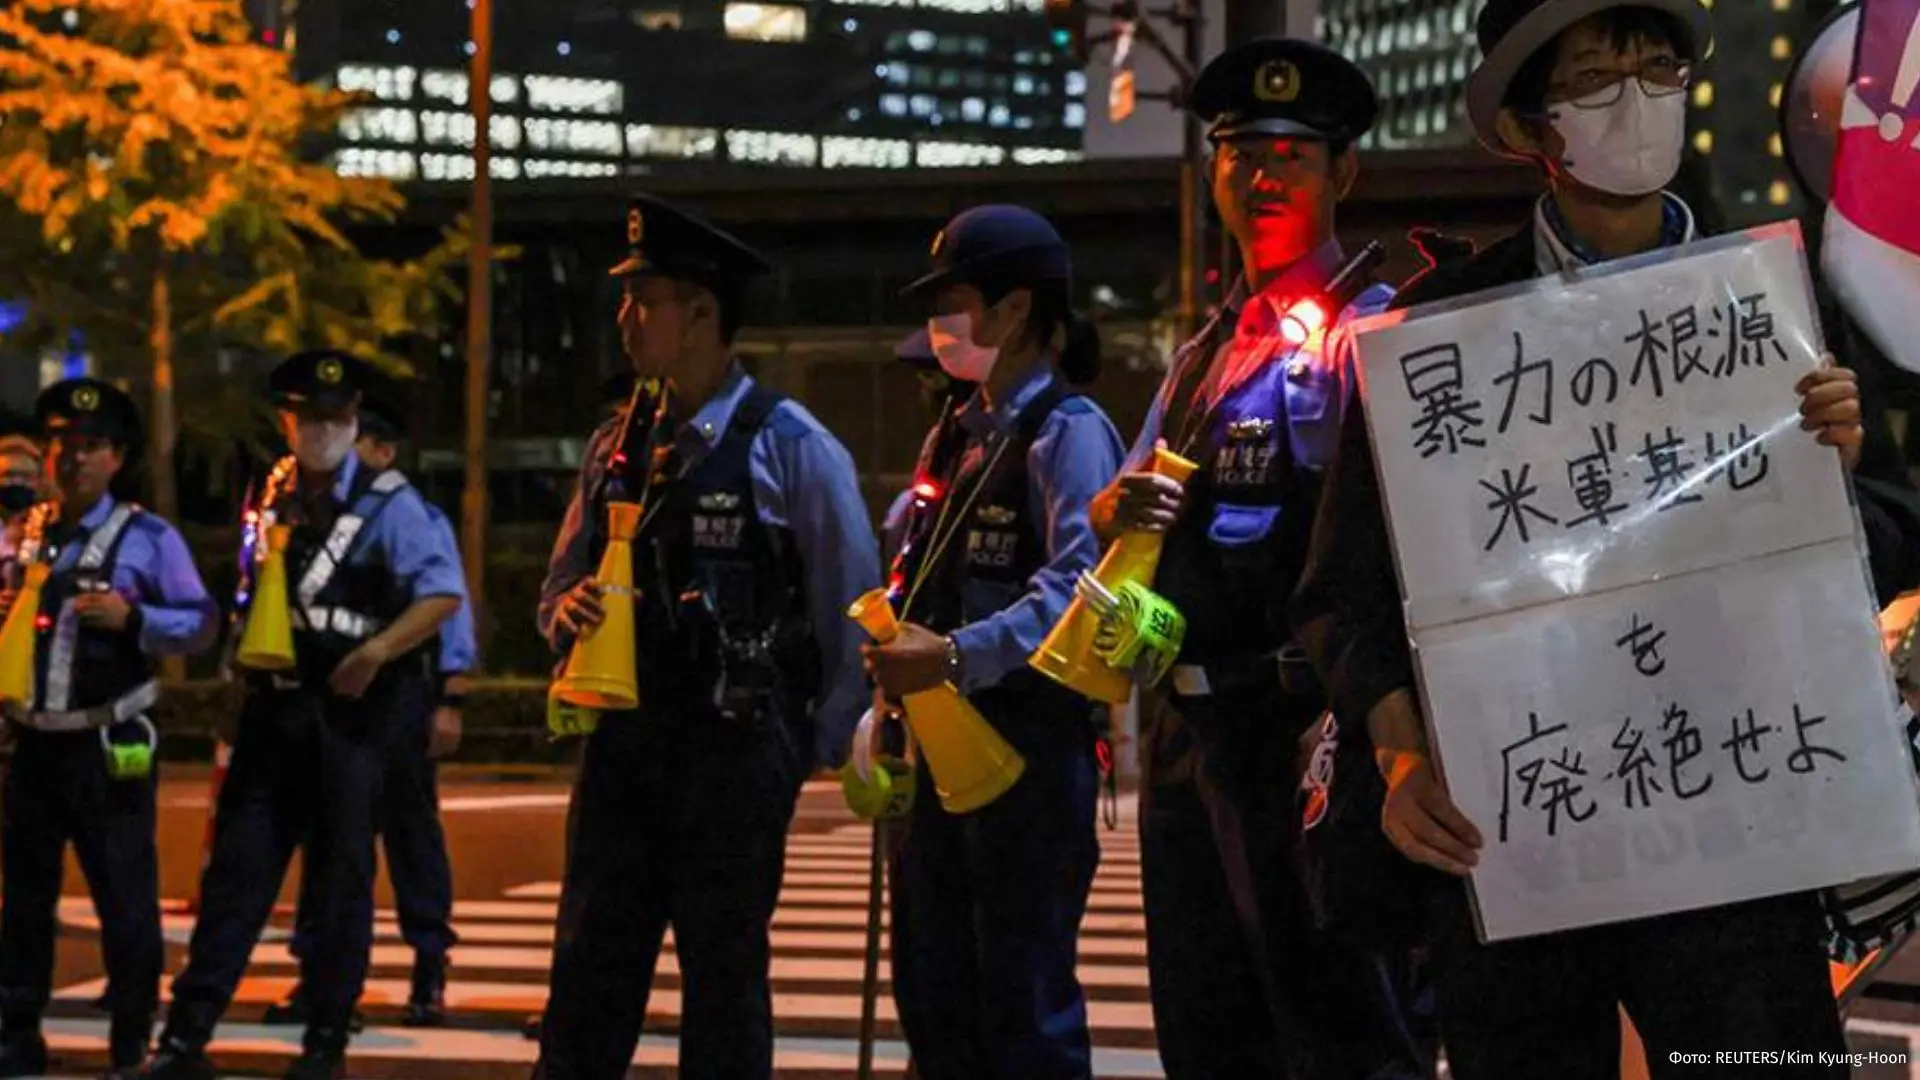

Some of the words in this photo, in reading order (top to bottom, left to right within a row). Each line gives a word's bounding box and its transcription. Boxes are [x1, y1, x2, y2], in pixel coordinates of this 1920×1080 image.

[1400, 292, 1788, 457] 暴力の根源
[1479, 420, 1769, 550] 米軍基地
[1617, 613, 1666, 676] を
[1499, 702, 1847, 843] 廃絶せよ
